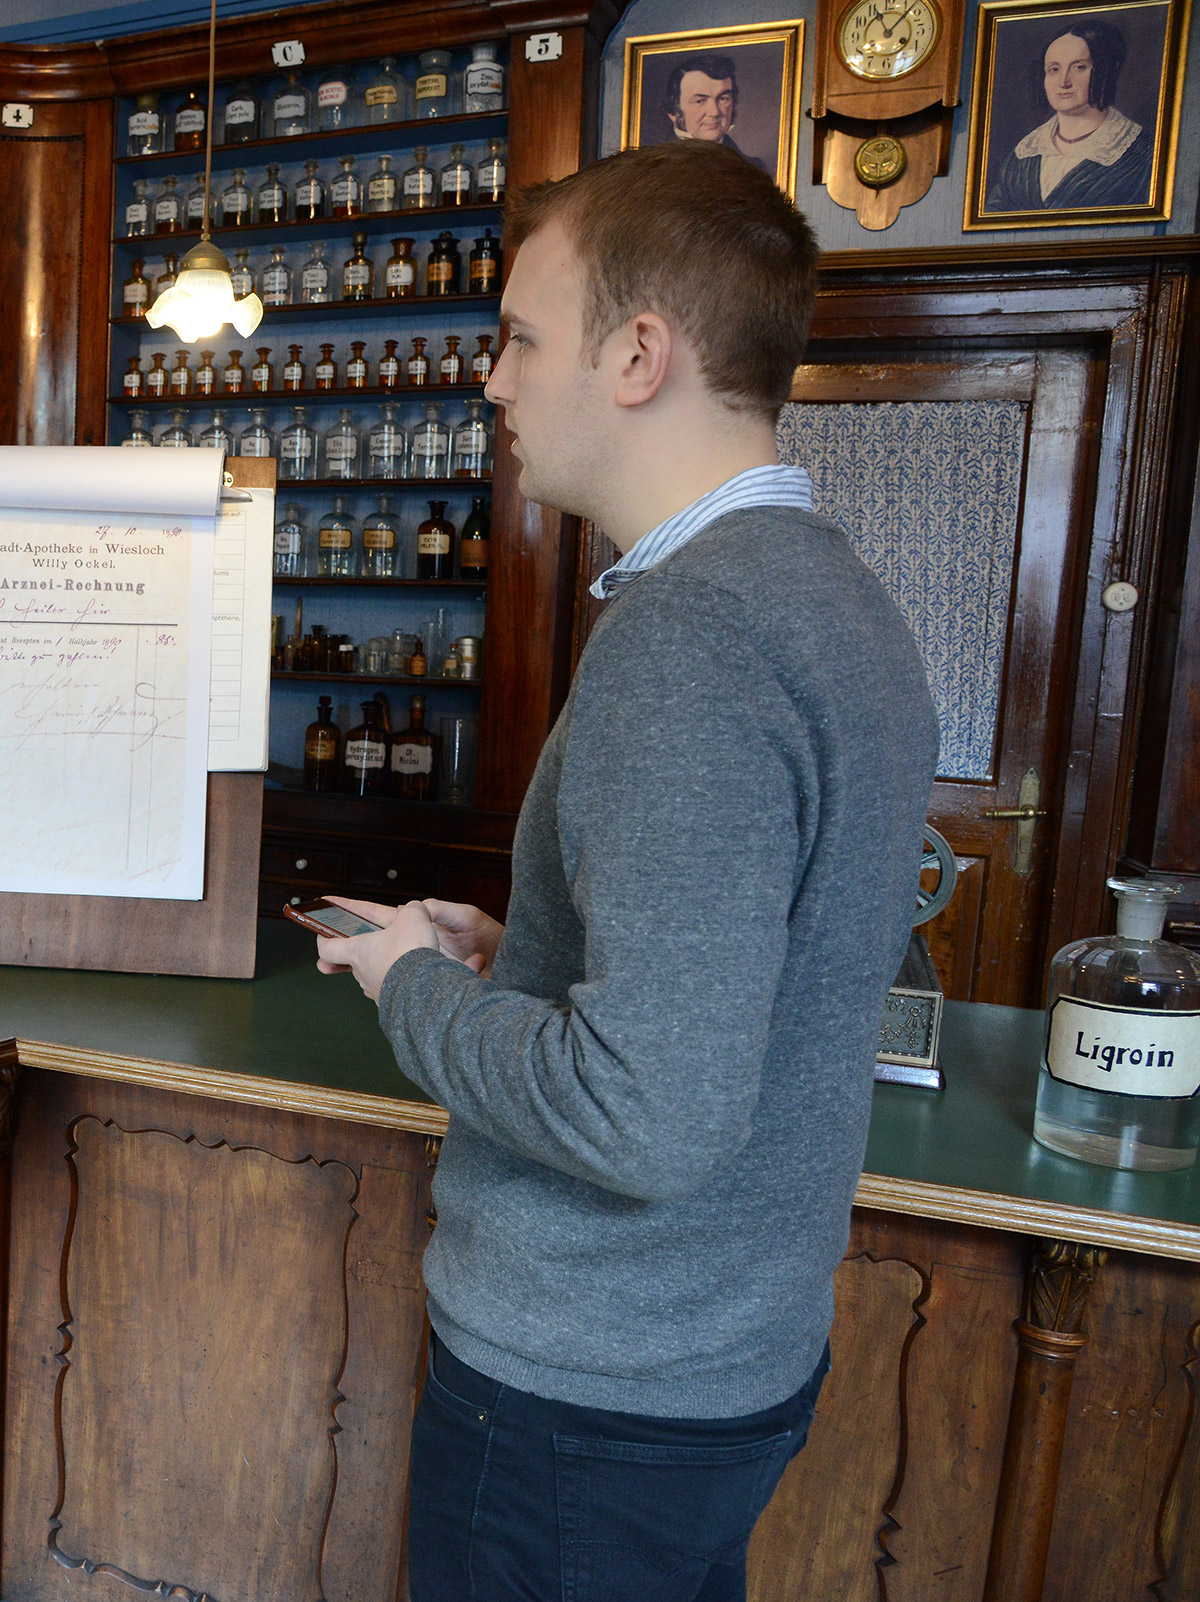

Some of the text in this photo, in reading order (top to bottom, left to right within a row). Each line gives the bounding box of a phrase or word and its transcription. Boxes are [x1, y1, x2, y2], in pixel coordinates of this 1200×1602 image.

[283, 45, 294, 63] C
[538, 39, 550, 56] 5
[12, 108, 22, 123] 4
[89, 546, 98, 554] in
[105, 543, 165, 555] Wiesloch
[32, 558, 116, 570] Willy Ockel.
[0, 577, 146, 595] Arznei-Rechnung
[43, 637, 52, 645] im
[1075, 1031, 1175, 1073] Ligroin
